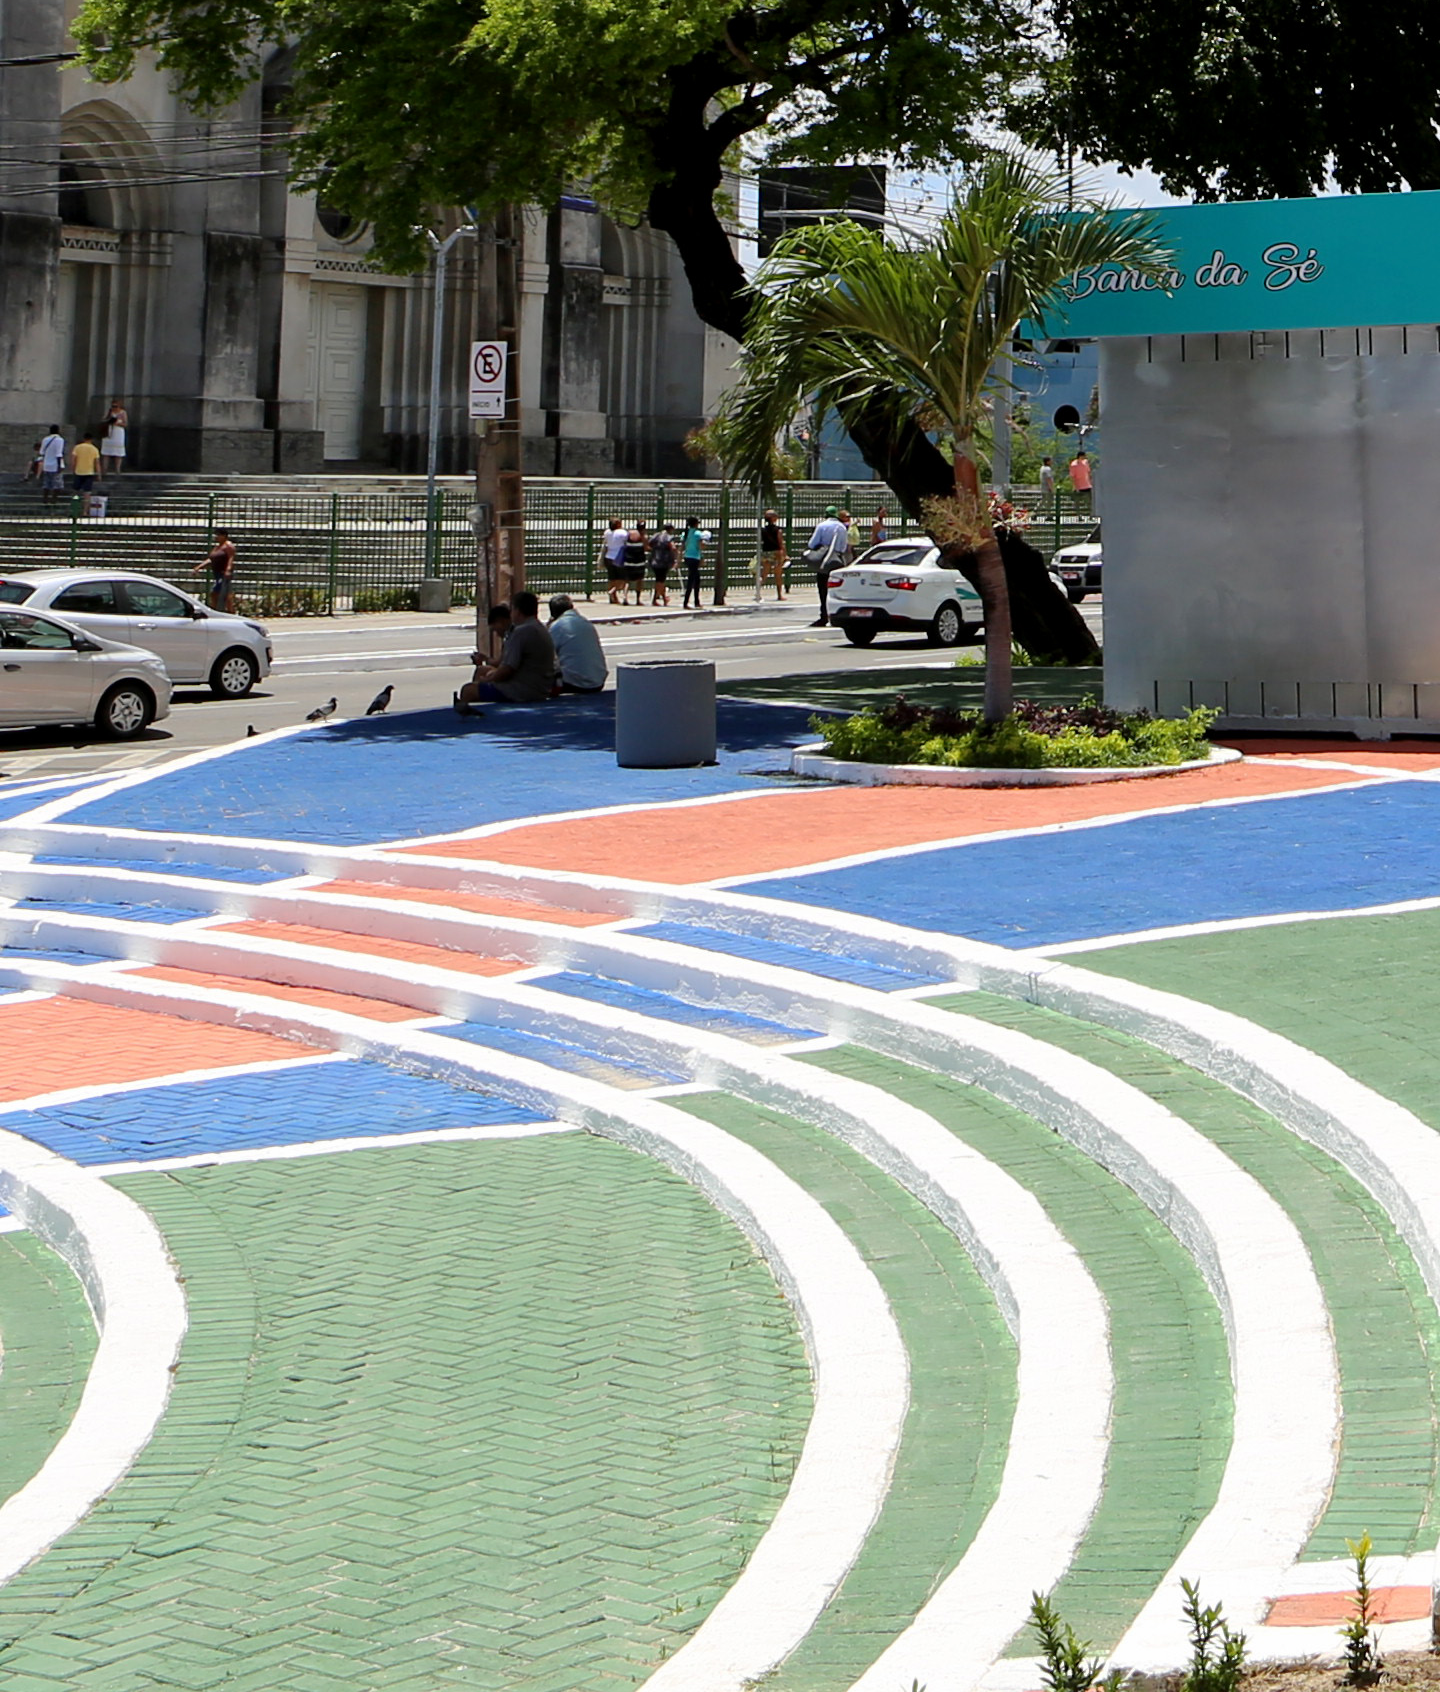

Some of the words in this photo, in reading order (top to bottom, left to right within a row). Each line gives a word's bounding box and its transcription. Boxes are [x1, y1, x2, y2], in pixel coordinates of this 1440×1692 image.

[1061, 259, 1185, 303] Banca
[1194, 249, 1249, 288] da
[1261, 241, 1325, 292] Sé
[483, 353, 494, 374] E
